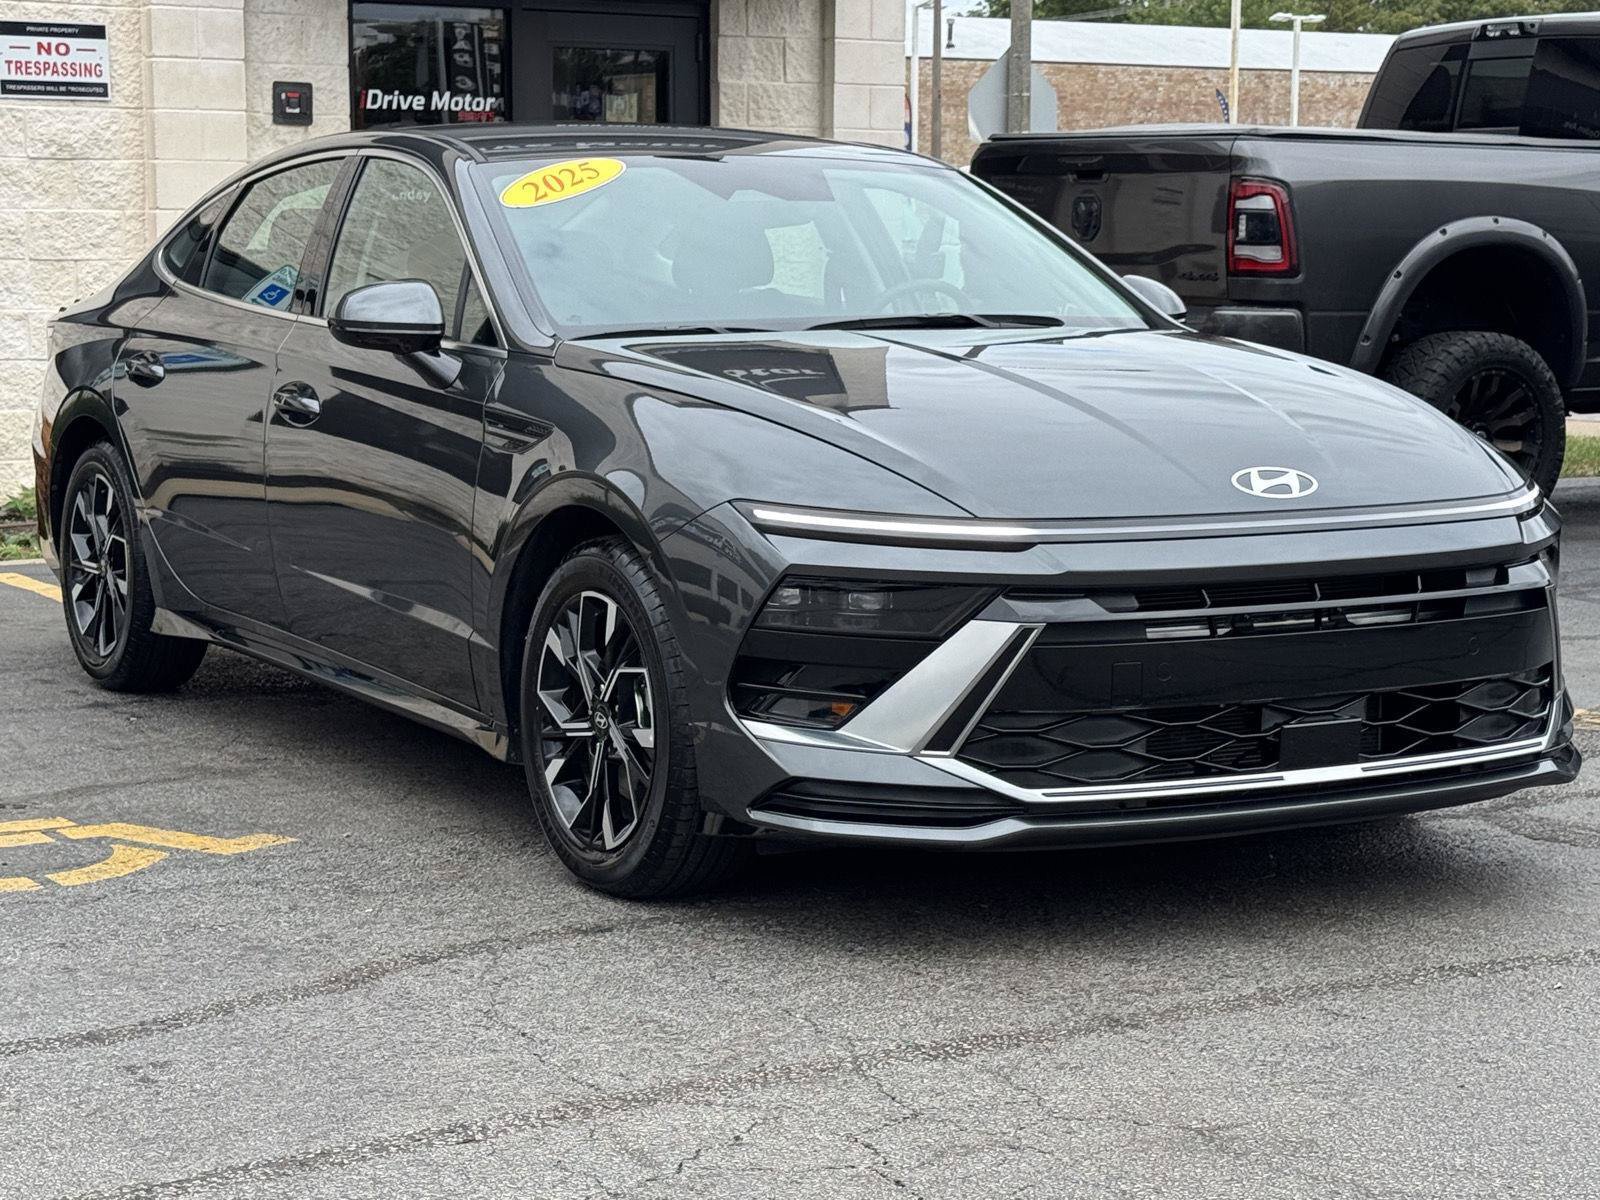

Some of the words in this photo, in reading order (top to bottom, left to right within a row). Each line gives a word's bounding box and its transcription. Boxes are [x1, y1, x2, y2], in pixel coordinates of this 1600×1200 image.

[36, 41, 71, 56] NO
[4, 60, 104, 78] TRESPASSING
[360, 89, 425, 111] iDrive
[430, 90, 496, 112] Motor
[521, 162, 600, 203] 2025
